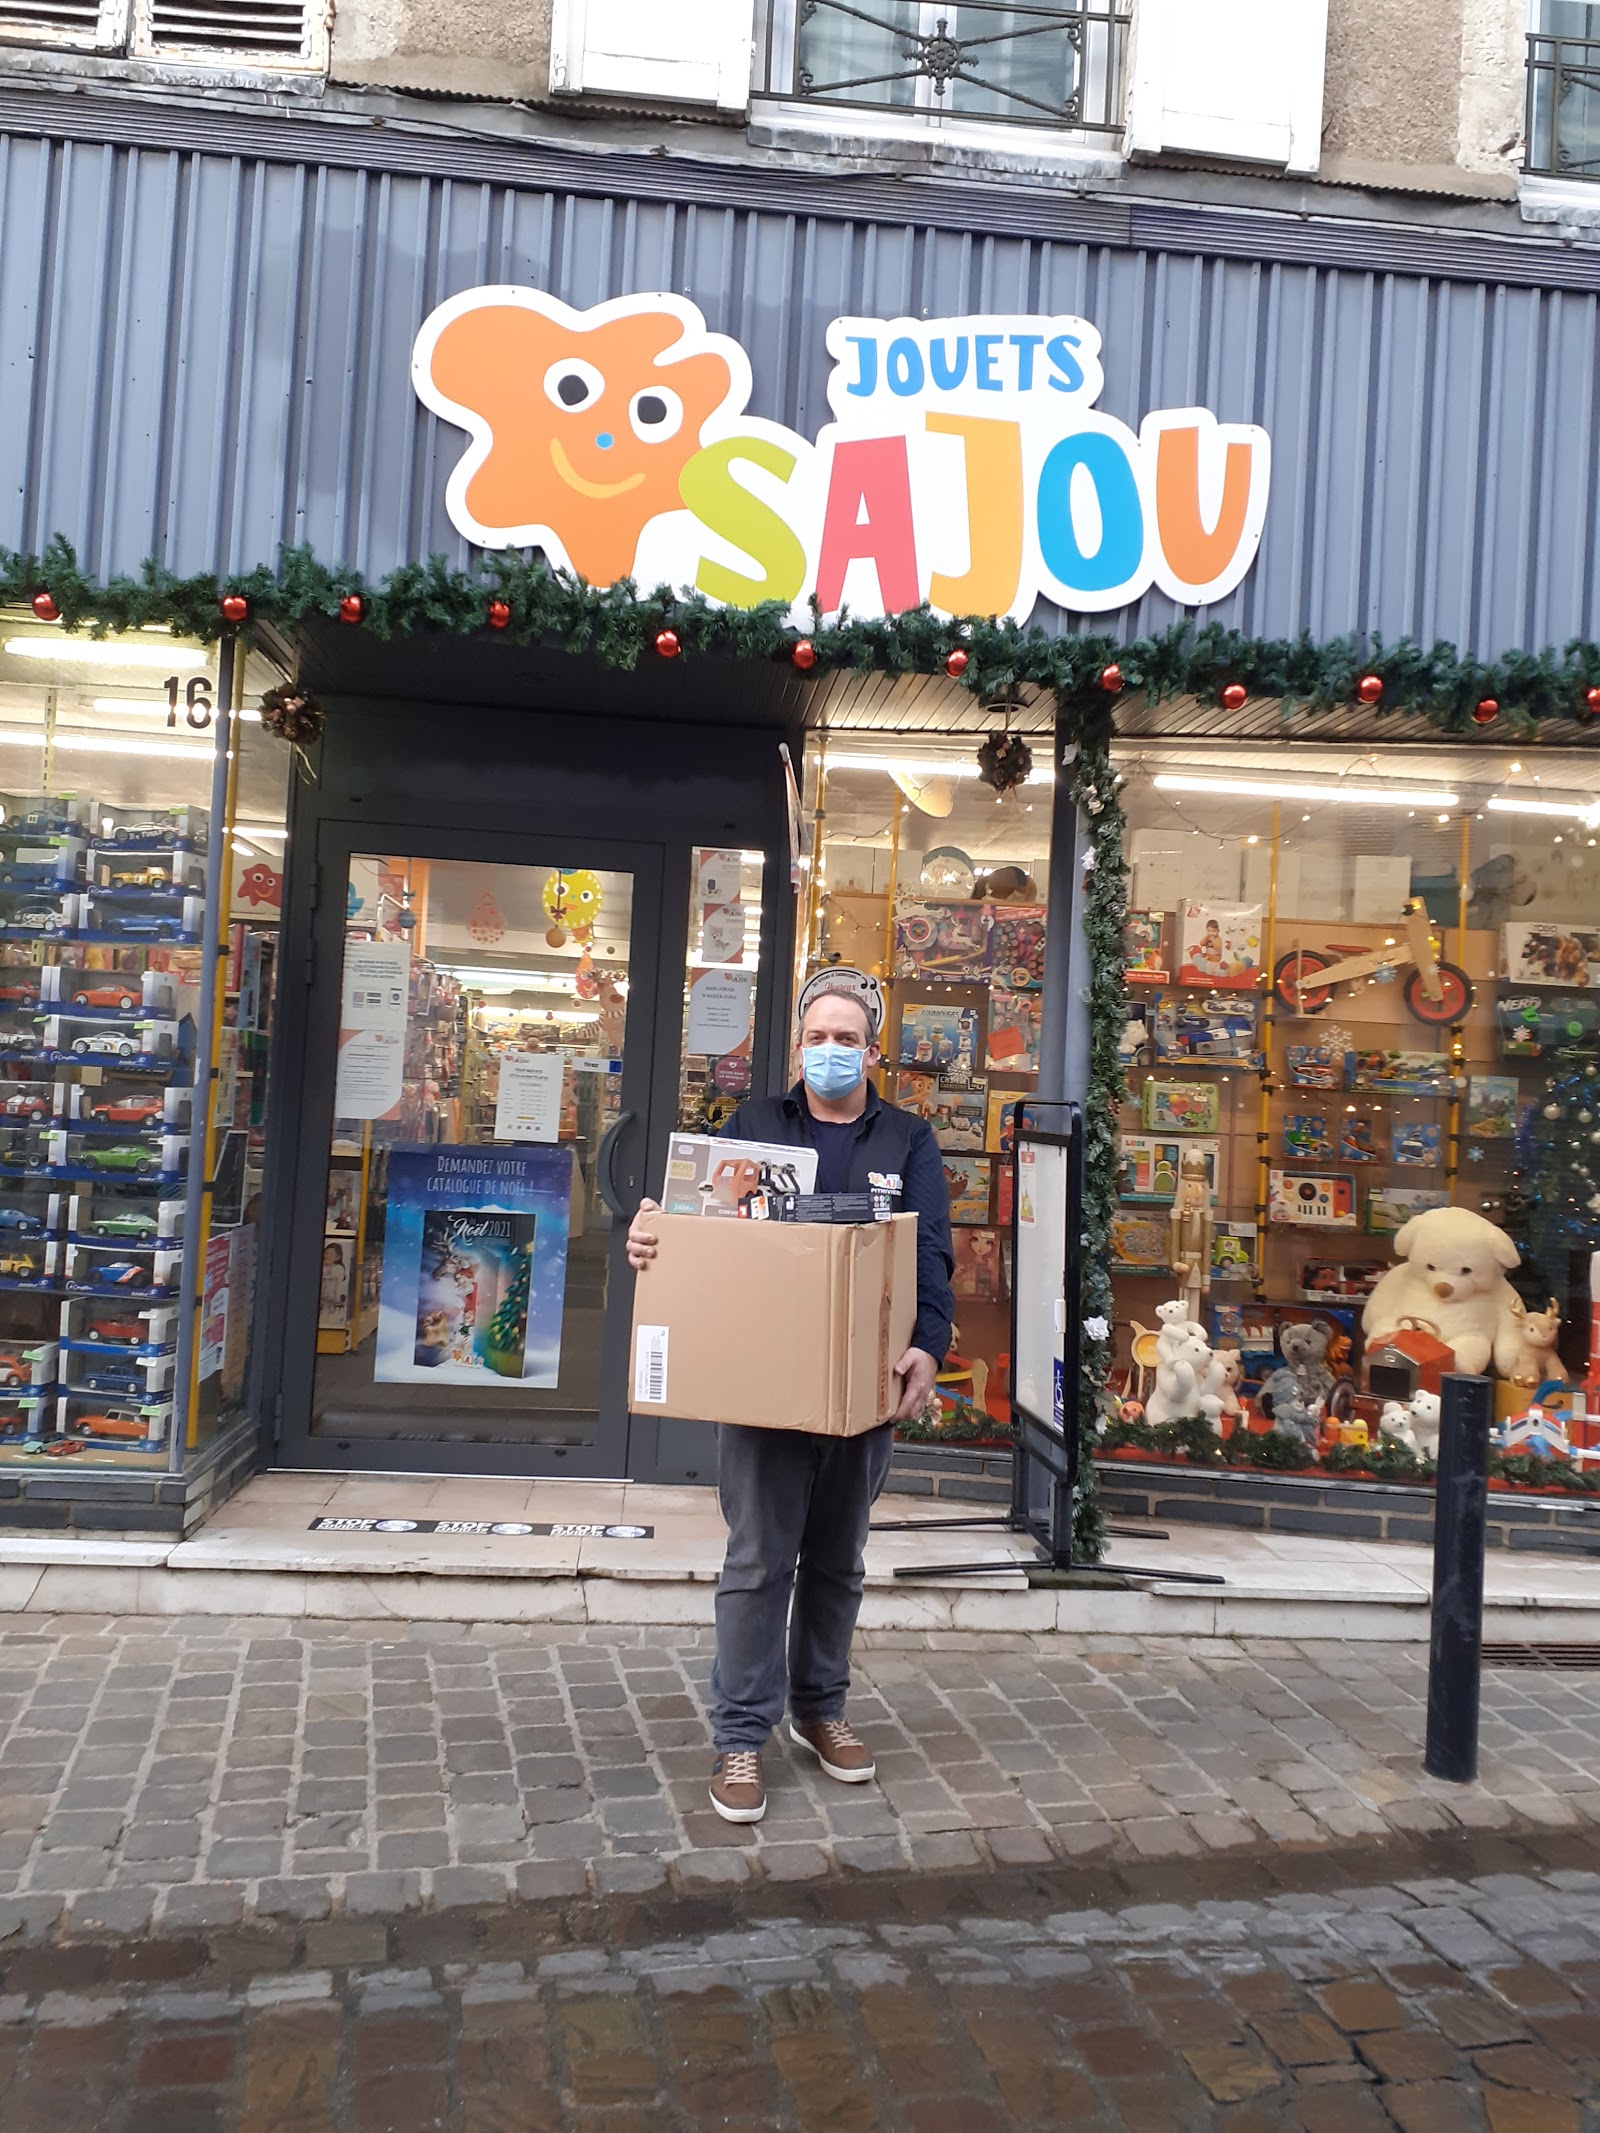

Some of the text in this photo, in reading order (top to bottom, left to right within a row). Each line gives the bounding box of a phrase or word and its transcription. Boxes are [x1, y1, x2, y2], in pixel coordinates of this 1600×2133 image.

[846, 333, 1084, 398] JOUETS
[678, 410, 1252, 617] SAJOU
[163, 676, 214, 730] 16
[1125, 1139, 1145, 1147] LUDI
[437, 1155, 527, 1176] DEMANDEZ VOTRE
[427, 1176, 534, 1197] CATALOGUE DE NOËL !
[449, 1216, 511, 1245] Noël 2021
[322, 1518, 378, 1527] STOP
[438, 1521, 492, 1530] STOP
[552, 1524, 606, 1533] STOP
